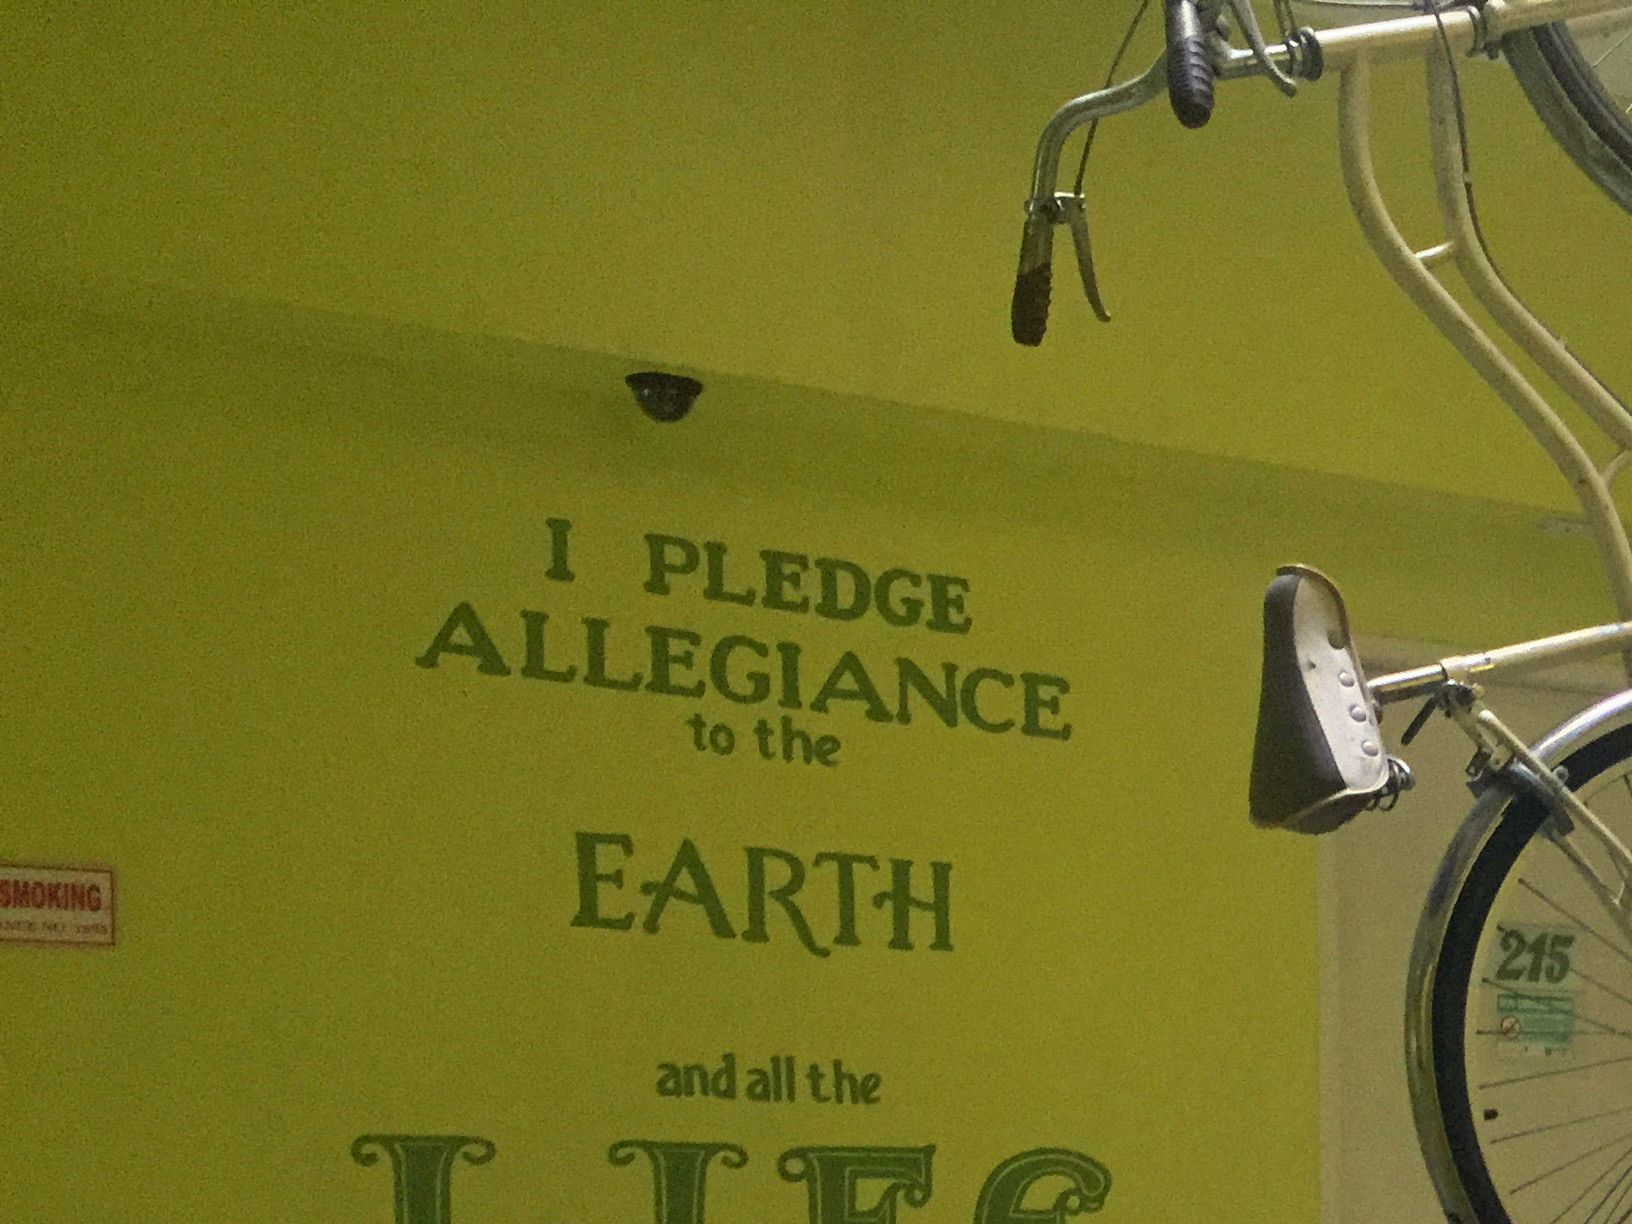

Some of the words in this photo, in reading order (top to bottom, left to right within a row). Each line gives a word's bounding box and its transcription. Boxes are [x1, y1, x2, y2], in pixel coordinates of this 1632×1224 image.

[545, 518, 572, 582] I
[643, 533, 974, 635] PLEDGE
[415, 601, 1072, 741] ALLEGIANCE
[687, 711, 736, 758] to
[753, 715, 842, 769] the
[0, 880, 101, 912] SMOKING
[569, 830, 955, 960] EARTH
[1495, 929, 1575, 983] 215
[656, 1053, 737, 1102] and
[746, 1055, 797, 1103] all
[807, 1059, 882, 1105] the
